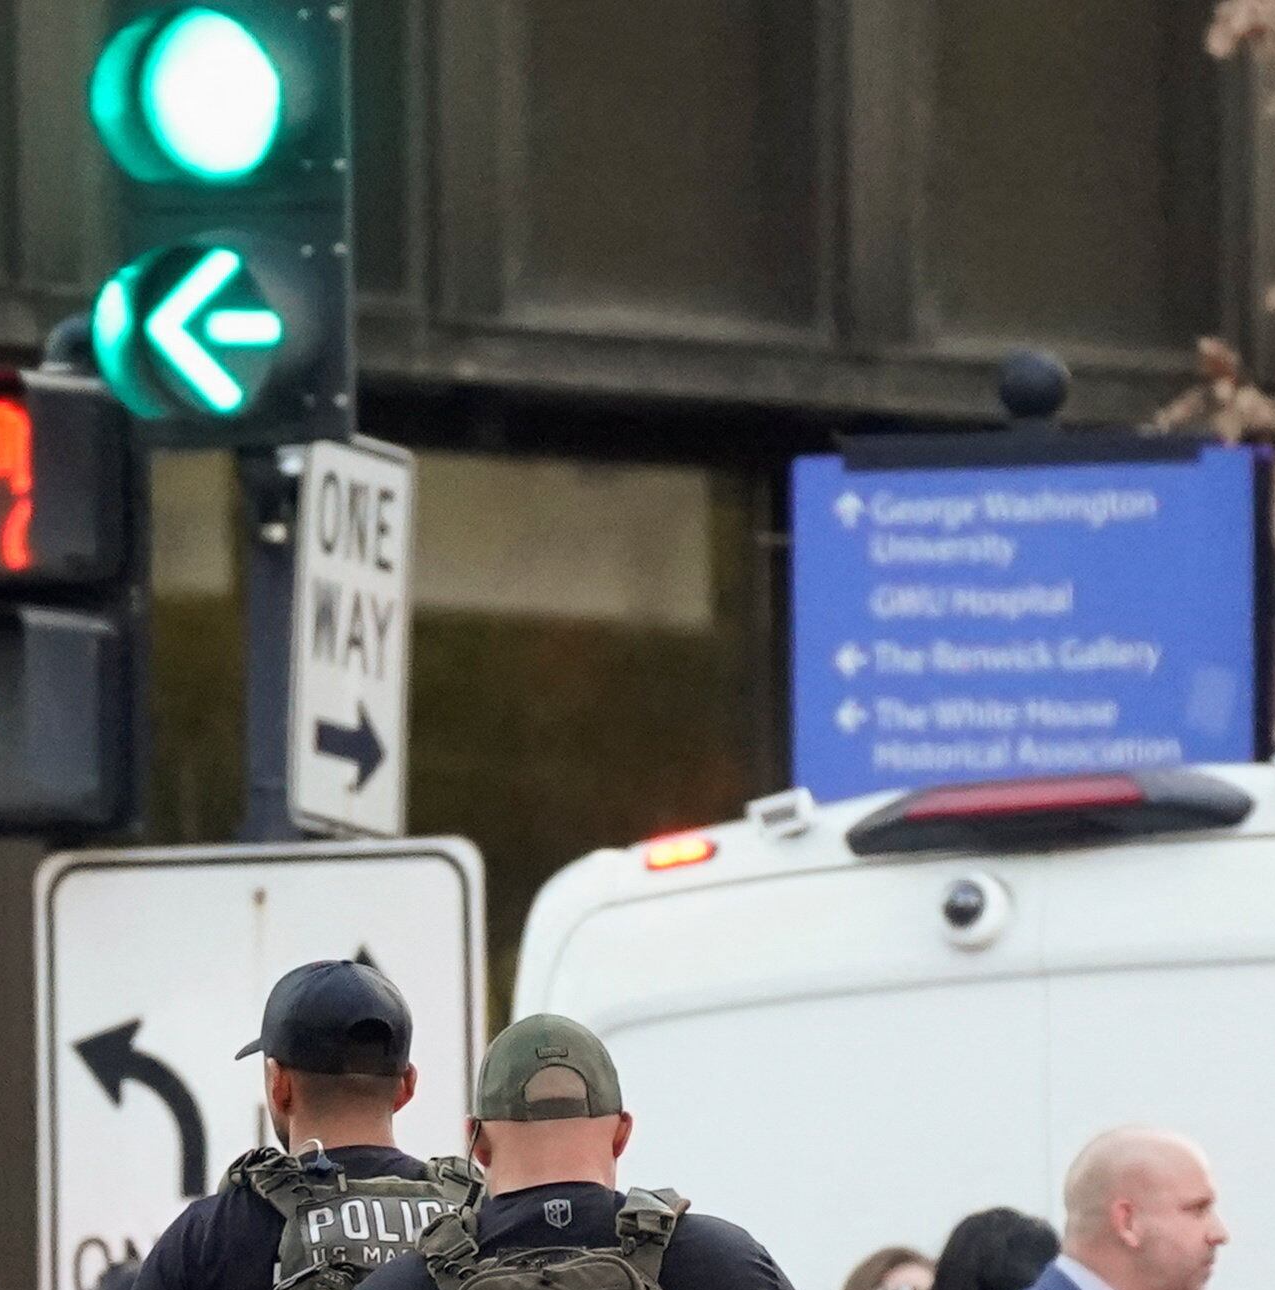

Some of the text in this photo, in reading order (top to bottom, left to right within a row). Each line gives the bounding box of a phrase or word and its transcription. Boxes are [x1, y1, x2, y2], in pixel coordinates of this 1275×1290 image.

[319, 471, 394, 571] ONE
[871, 487, 1158, 529] George Washington
[870, 532, 1015, 569] University
[952, 581, 1073, 621] Hospital
[312, 576, 395, 681] WAY
[873, 639, 925, 673] The
[1059, 633, 1162, 676] Gallery
[875, 696, 1119, 730] The White House
[872, 735, 1182, 772] Historical Association
[307, 1200, 455, 1244] POLIC
